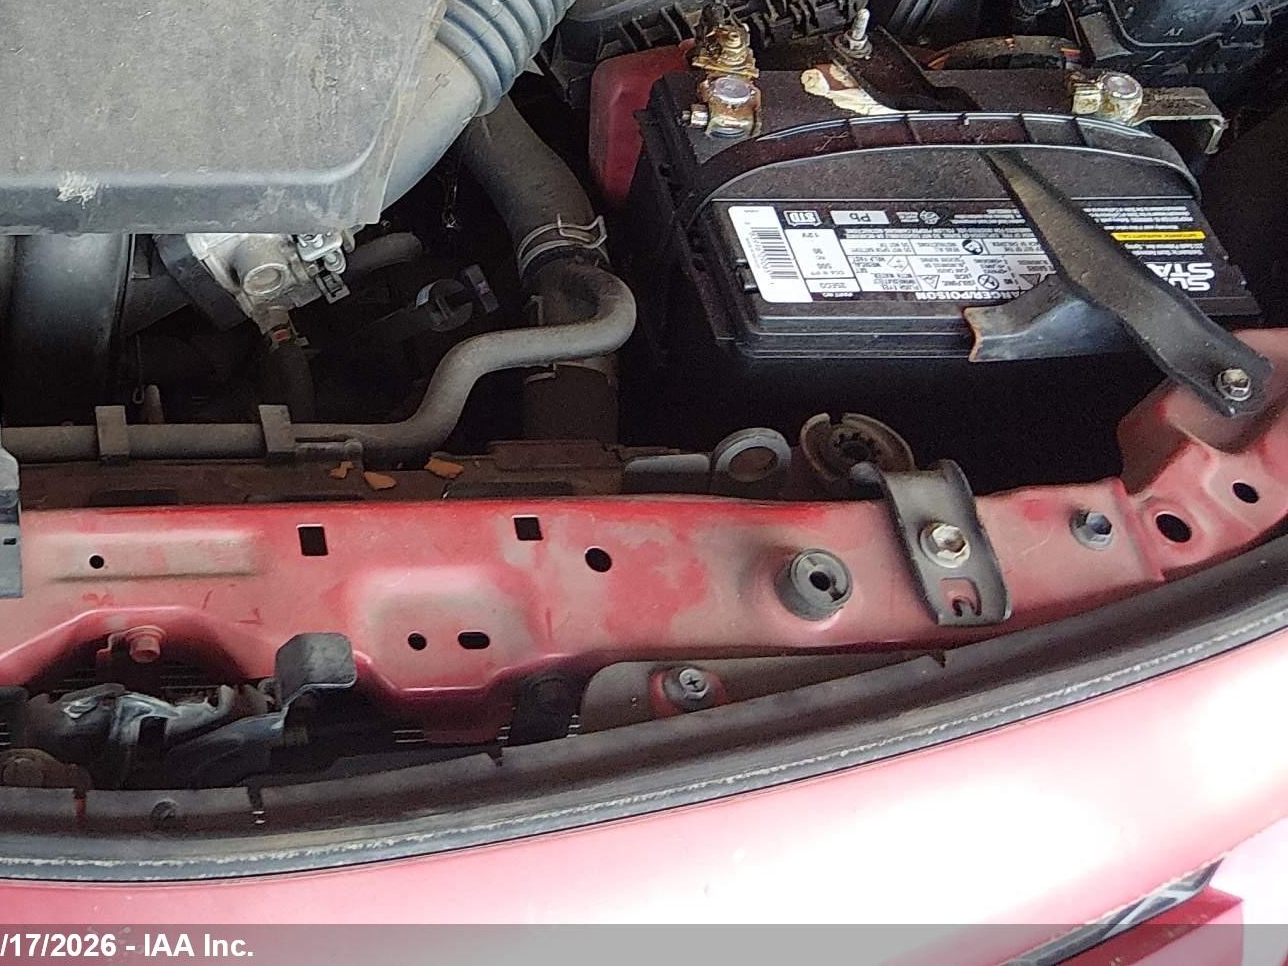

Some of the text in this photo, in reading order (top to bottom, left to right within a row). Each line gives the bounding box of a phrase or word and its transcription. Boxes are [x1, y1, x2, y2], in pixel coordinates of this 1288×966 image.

[850, 213, 872, 222] Pb
[1163, 277, 1211, 291] SU
[915, 291, 1024, 300] ANGER/POISON
